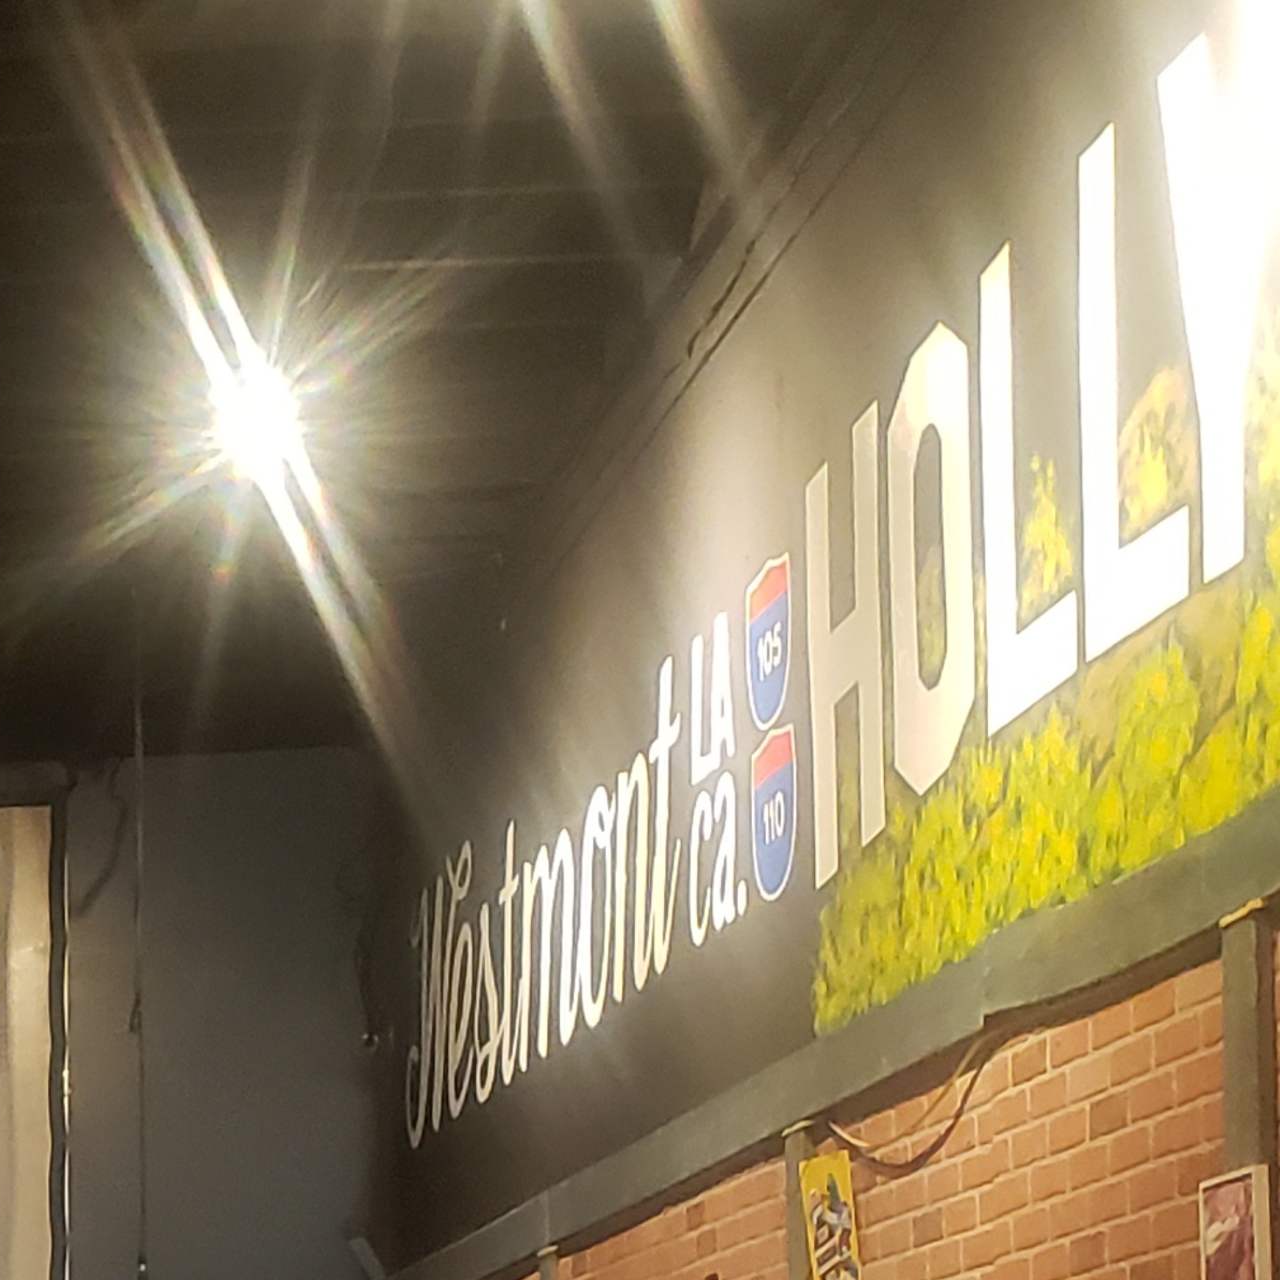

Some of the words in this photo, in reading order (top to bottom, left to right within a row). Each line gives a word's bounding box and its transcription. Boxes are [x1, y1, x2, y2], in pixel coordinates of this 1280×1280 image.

[691, 611, 736, 785] LA
[754, 620, 783, 682] 105
[761, 802, 786, 847] 110
[406, 655, 683, 1148] Westmont
